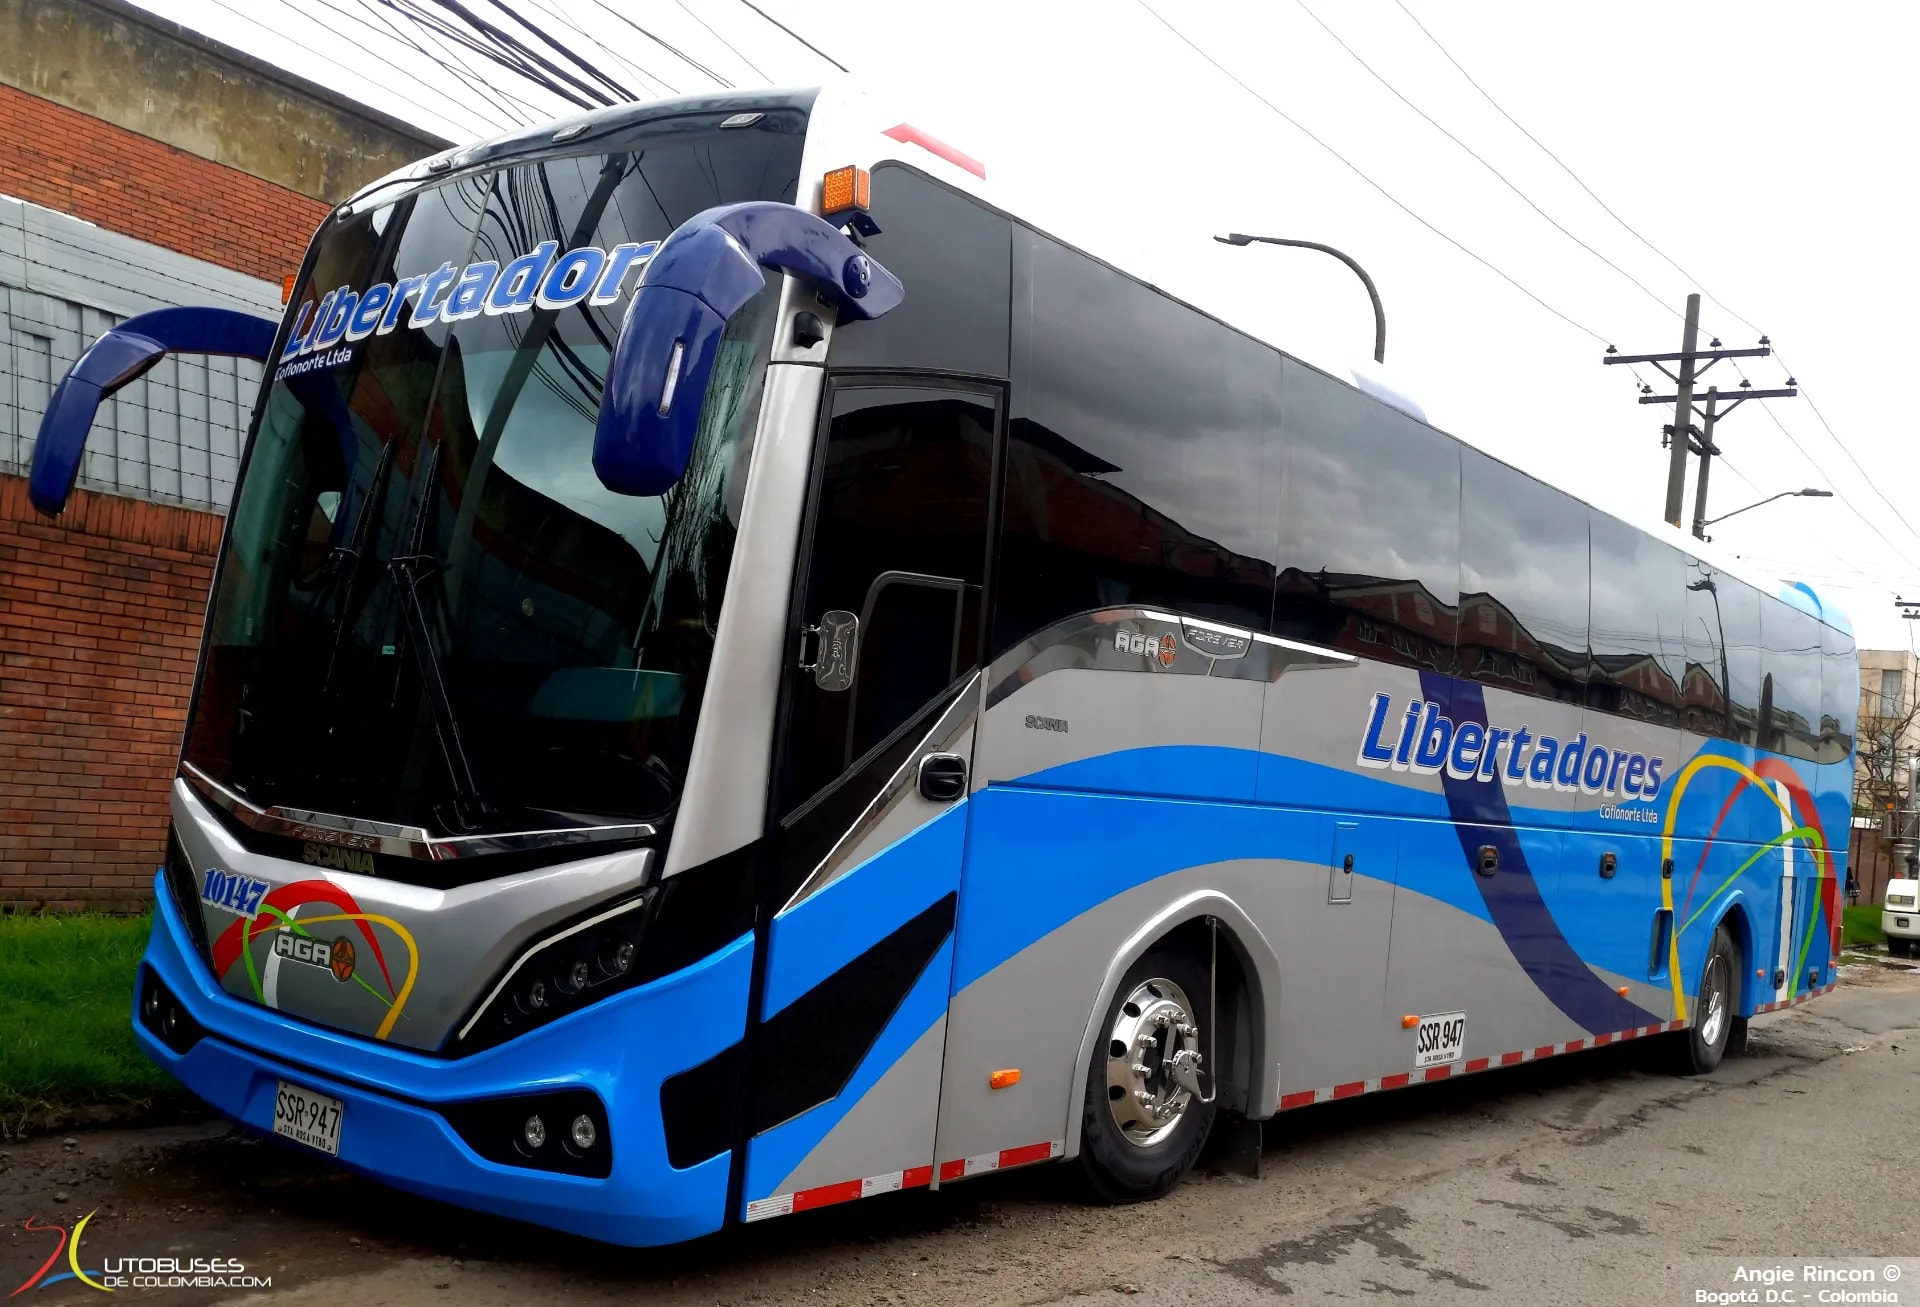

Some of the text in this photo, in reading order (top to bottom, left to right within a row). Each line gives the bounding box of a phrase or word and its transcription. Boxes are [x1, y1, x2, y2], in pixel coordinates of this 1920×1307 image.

[278, 240, 662, 365] Libertador
[326, 347, 352, 366] Ltda
[1114, 629, 1160, 658] AGA
[1187, 628, 1245, 650] FOREVER
[1024, 714, 1069, 734] SCANIA
[1357, 691, 1663, 801] Libertadores
[1599, 803, 1658, 824] Coflonorte Ltda
[292, 825, 375, 849] FOREVER
[303, 842, 376, 875] SCANIA
[201, 868, 270, 920] 10147
[275, 934, 331, 966] AGA
[1418, 1018, 1464, 1053] SSR 947
[276, 1090, 339, 1138] SSR 947
